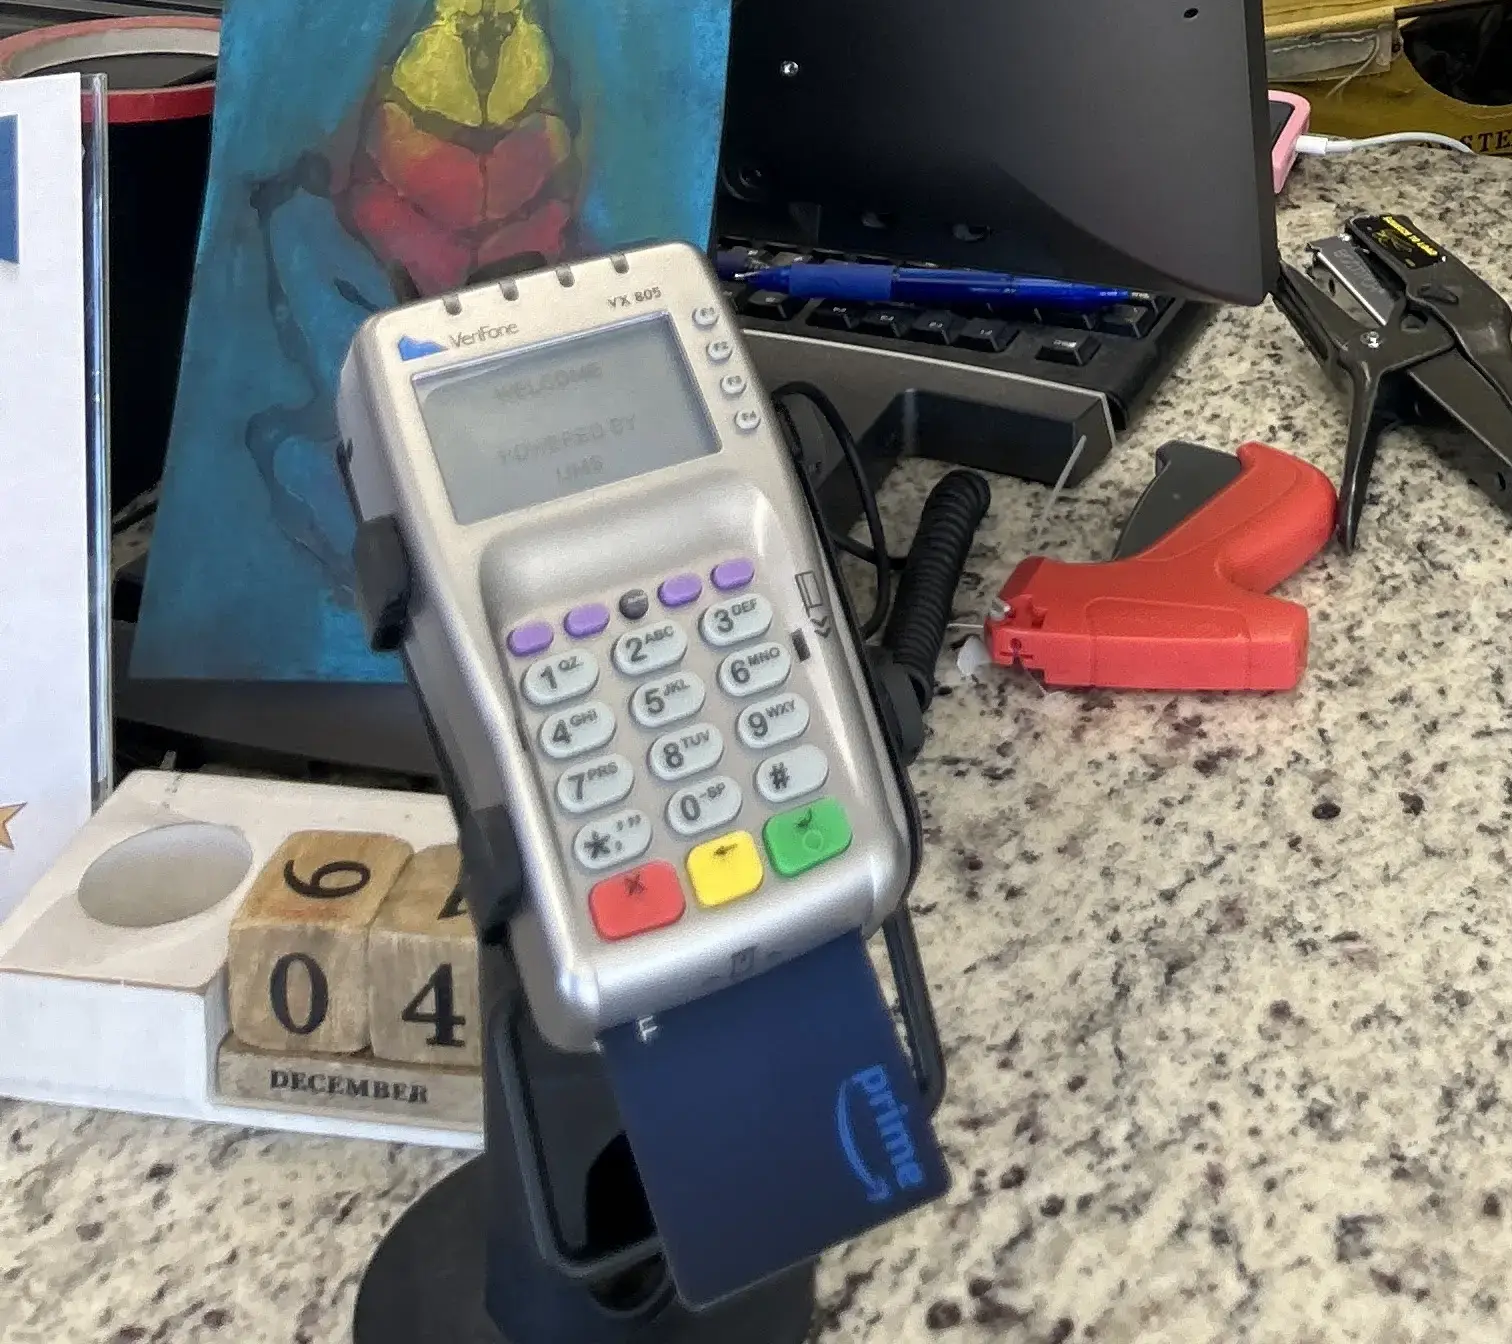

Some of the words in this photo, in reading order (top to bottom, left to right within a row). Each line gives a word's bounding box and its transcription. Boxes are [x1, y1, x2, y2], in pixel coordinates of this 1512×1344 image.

[713, 610, 734, 633] 3
[625, 637, 648, 662] 2
[540, 665, 558, 690] 1
[730, 660, 751, 684] 6
[645, 688, 665, 715] 5
[552, 719, 572, 745] 4
[748, 714, 769, 738] 9
[663, 742, 684, 768] 8
[567, 772, 585, 800] 7
[680, 794, 701, 821] 0
[268, 951, 329, 1036] 0
[401, 962, 466, 1048] 4
[269, 1068, 430, 1105] DECEMBER
[850, 1063, 925, 1189] prime
